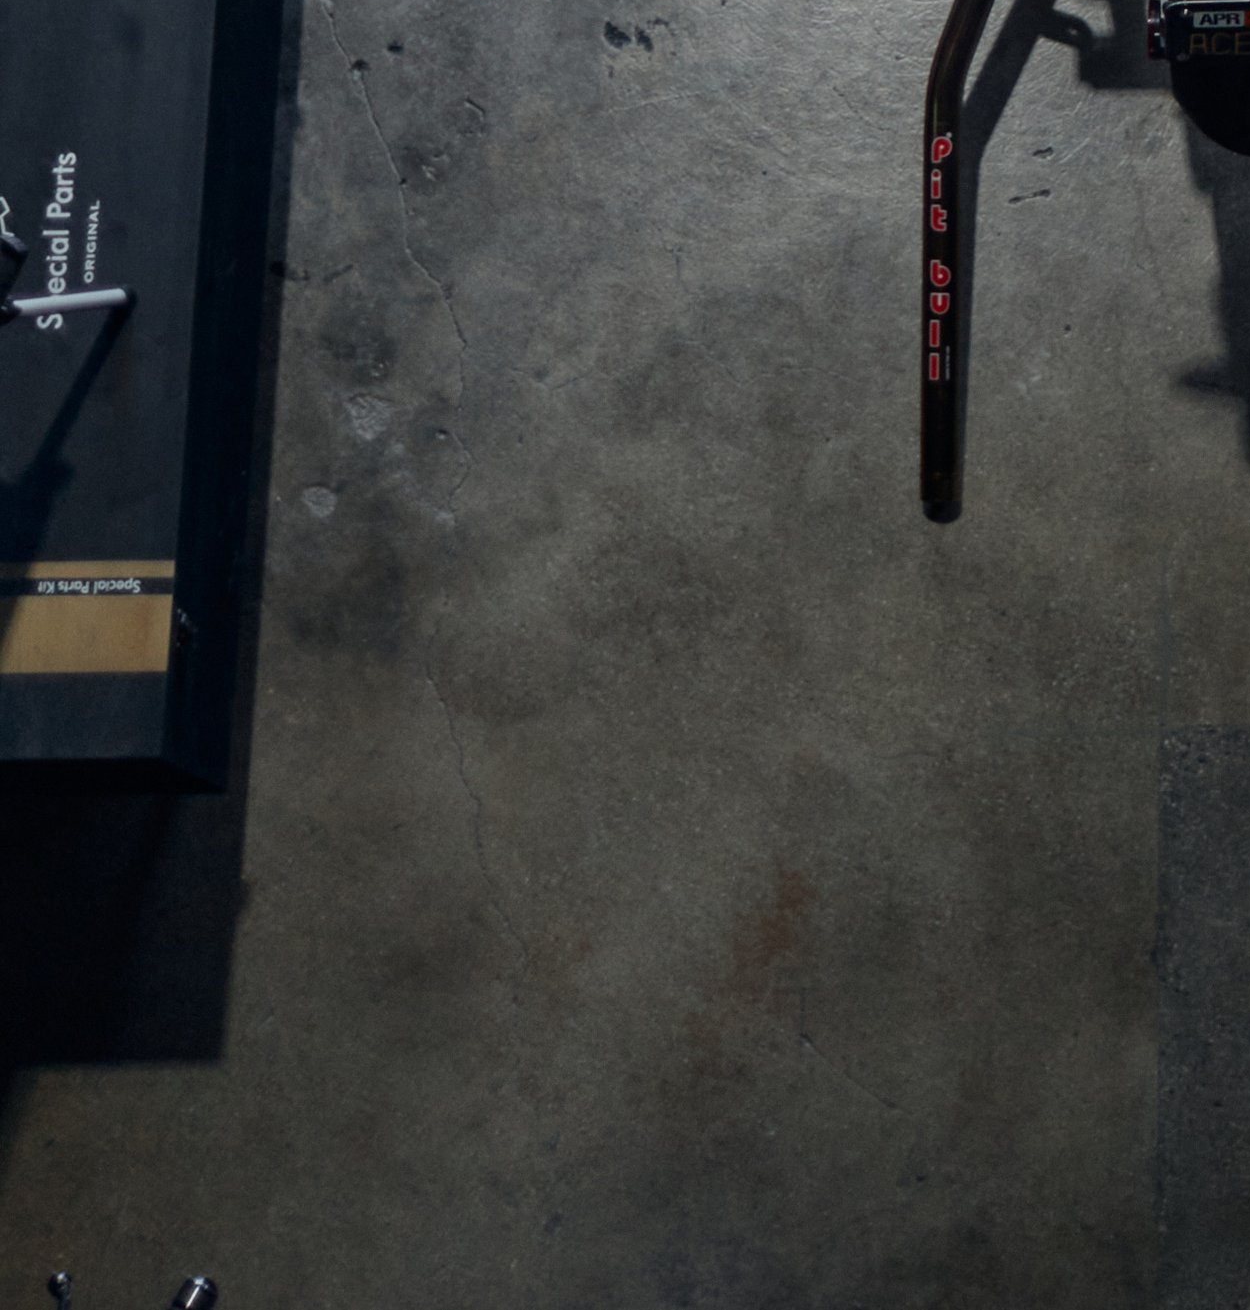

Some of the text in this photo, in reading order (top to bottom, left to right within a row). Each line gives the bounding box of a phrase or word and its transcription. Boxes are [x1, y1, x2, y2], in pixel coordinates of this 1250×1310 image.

[1198, 12, 1241, 26] APR
[36, 151, 78, 330] Secial Parts
[83, 199, 101, 284] ORIGINAL
[37, 577, 142, 594] Special Parts Kit
